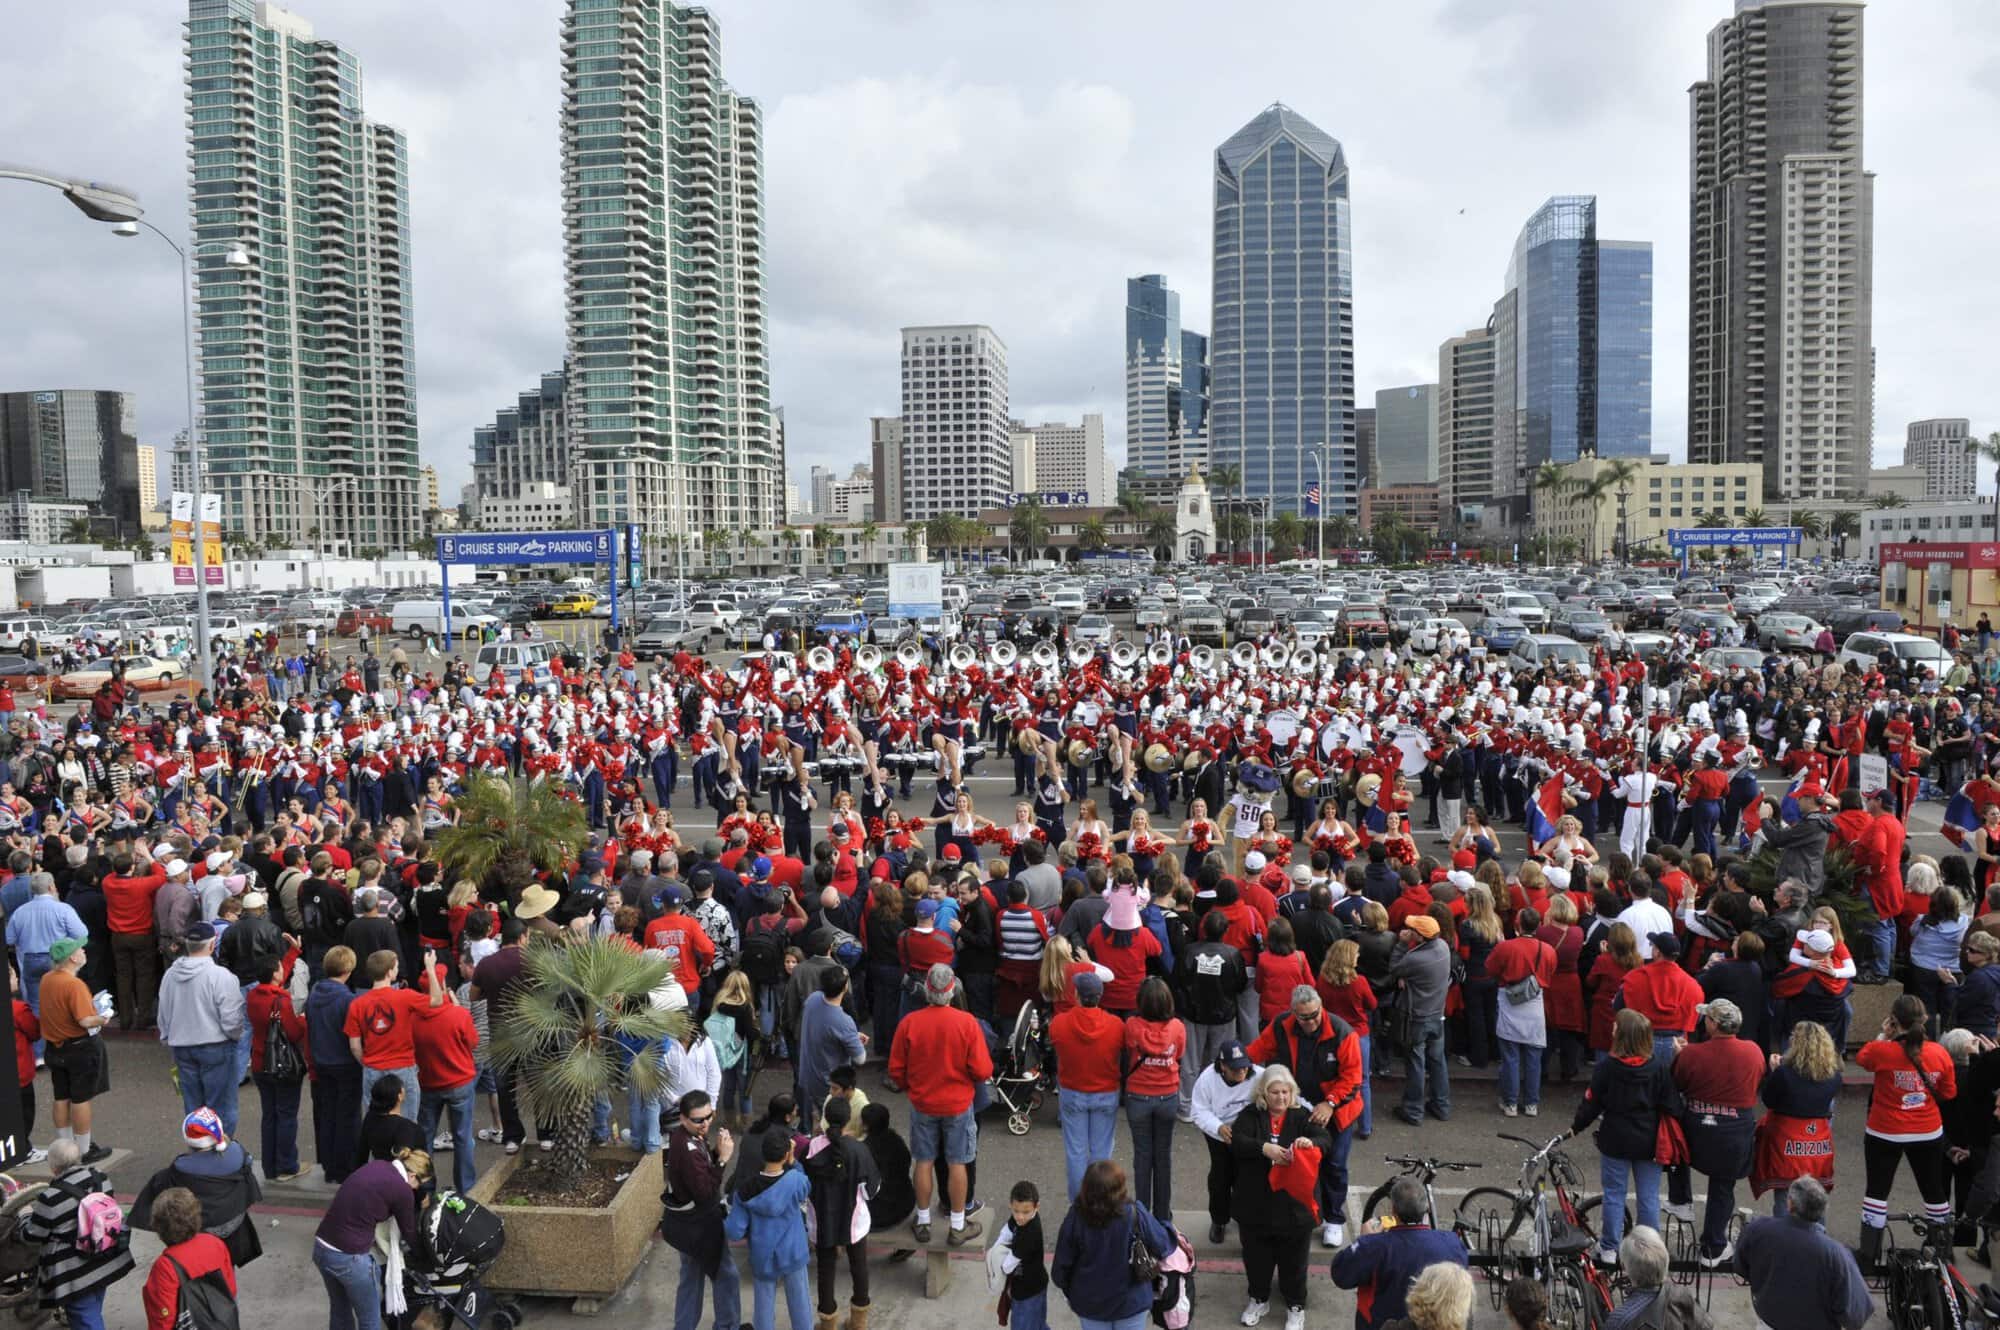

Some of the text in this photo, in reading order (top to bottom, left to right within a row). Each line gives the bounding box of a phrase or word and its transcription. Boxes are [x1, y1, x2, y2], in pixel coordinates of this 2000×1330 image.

[444, 540, 453, 552] 5
[458, 540, 593, 555] CRUISE SHIP PARKING
[598, 536, 607, 549] 5
[1241, 804, 1260, 822] 50
